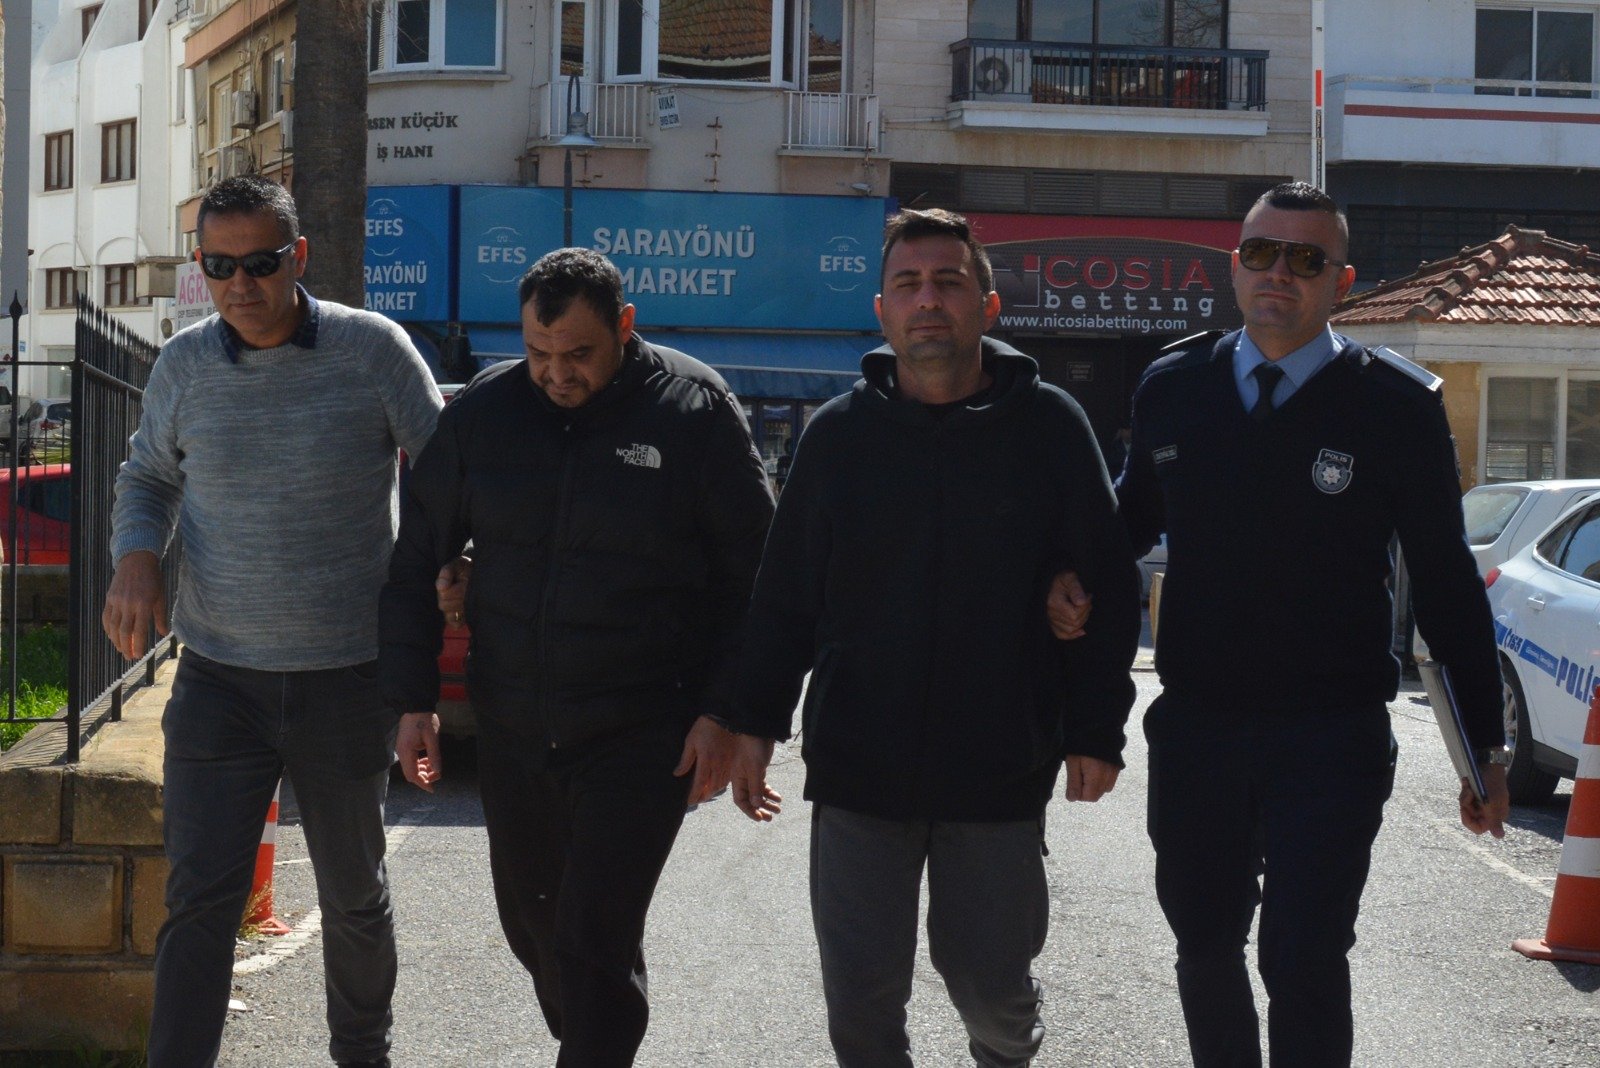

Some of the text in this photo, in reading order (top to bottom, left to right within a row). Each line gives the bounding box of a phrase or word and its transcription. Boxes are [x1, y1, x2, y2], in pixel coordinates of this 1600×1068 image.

[401, 112, 459, 132] KÜÇÜK
[377, 143, 433, 162] İŞ HANI
[364, 218, 404, 237] EFES
[593, 224, 755, 258] SARAYÖNÜ
[478, 245, 526, 264] EFES
[819, 254, 867, 273] EFES
[618, 267, 737, 297] MARKET
[1000, 313, 1187, 333] www.nicosiabetting.com
[616, 448, 647, 460] NORTH
[632, 443, 649, 452] THE
[624, 456, 646, 467] FACE
